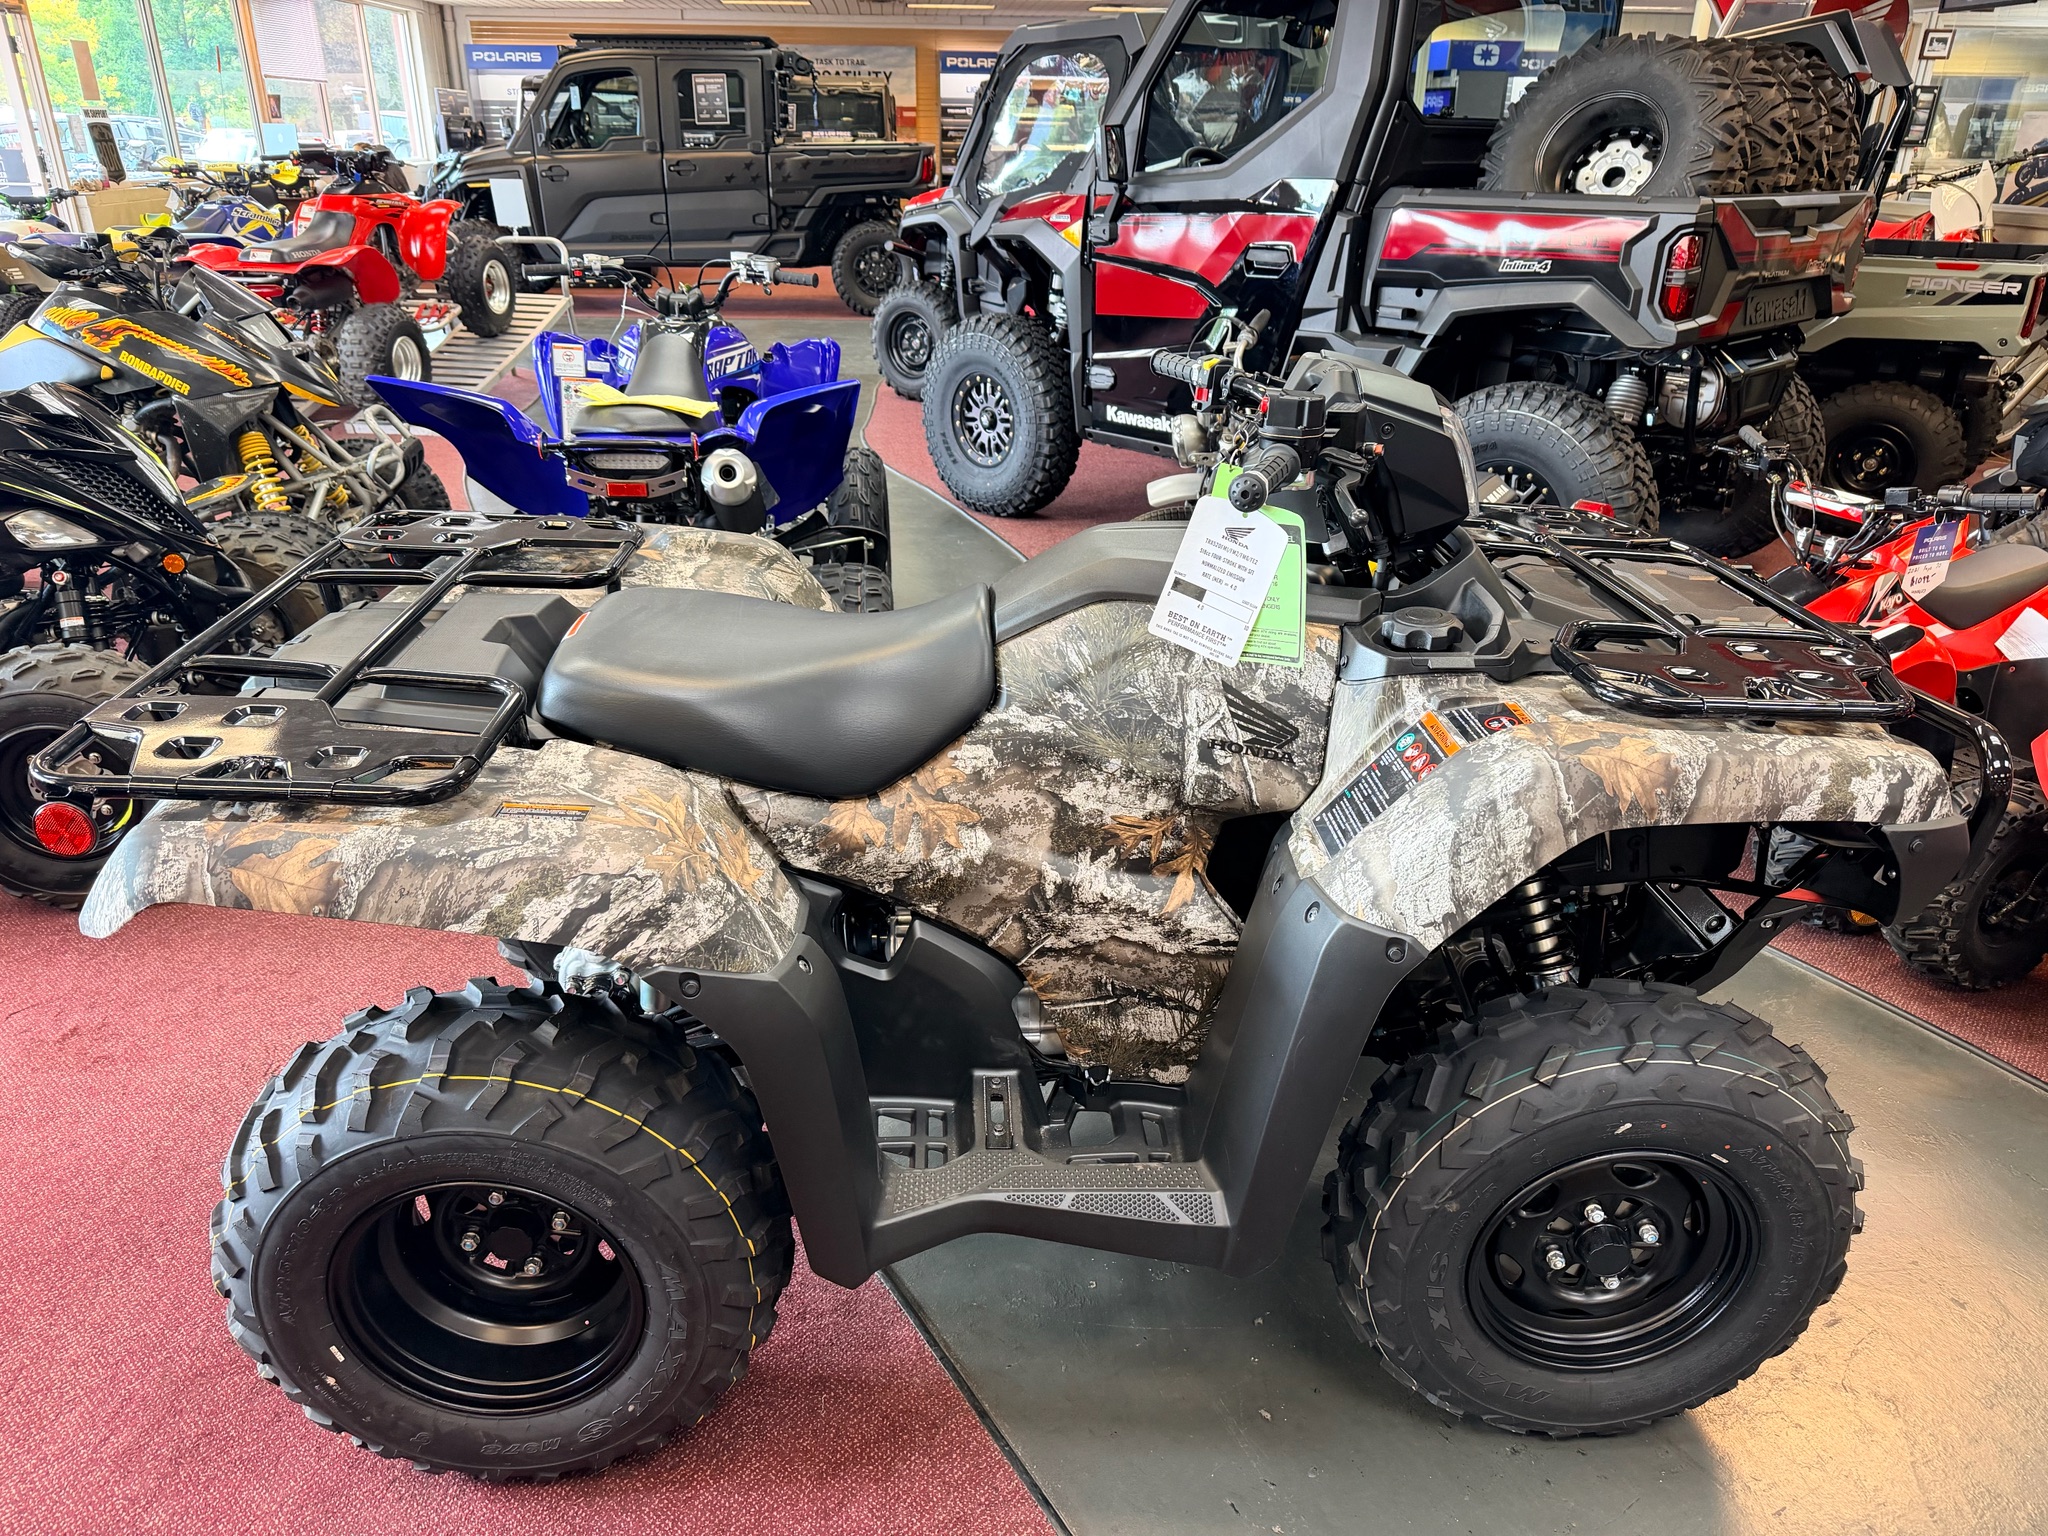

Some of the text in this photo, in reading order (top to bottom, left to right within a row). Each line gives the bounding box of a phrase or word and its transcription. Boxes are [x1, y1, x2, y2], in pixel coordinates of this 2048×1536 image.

[472, 52, 542, 62] POLARIS
[947, 57, 998, 67] POLAR
[90, 109, 109, 118] SUPPORT
[231, 206, 283, 228] Scrambler
[291, 248, 322, 259] HONDA
[1499, 259, 1552, 273] Inline-4
[1906, 276, 2022, 296] PIONEER
[1744, 288, 1808, 327] Kawasaki
[119, 350, 191, 396] BOMBARDIER
[1222, 535, 1249, 550] HONDA
[1923, 535, 1947, 544] POLARIS
[1202, 560, 1226, 576] NORMALIZED
[1226, 570, 1246, 583] EMISSION
[1879, 592, 1903, 612] Kayo
[1167, 618, 1204, 640] PERFORMANCE
[1168, 610, 1188, 624] BEST
[1190, 620, 1200, 630] ON
[1207, 738, 1295, 764] HONDA
[1426, 1252, 1551, 1405] MAXXIS
[578, 1262, 688, 1443] MAXXIS
